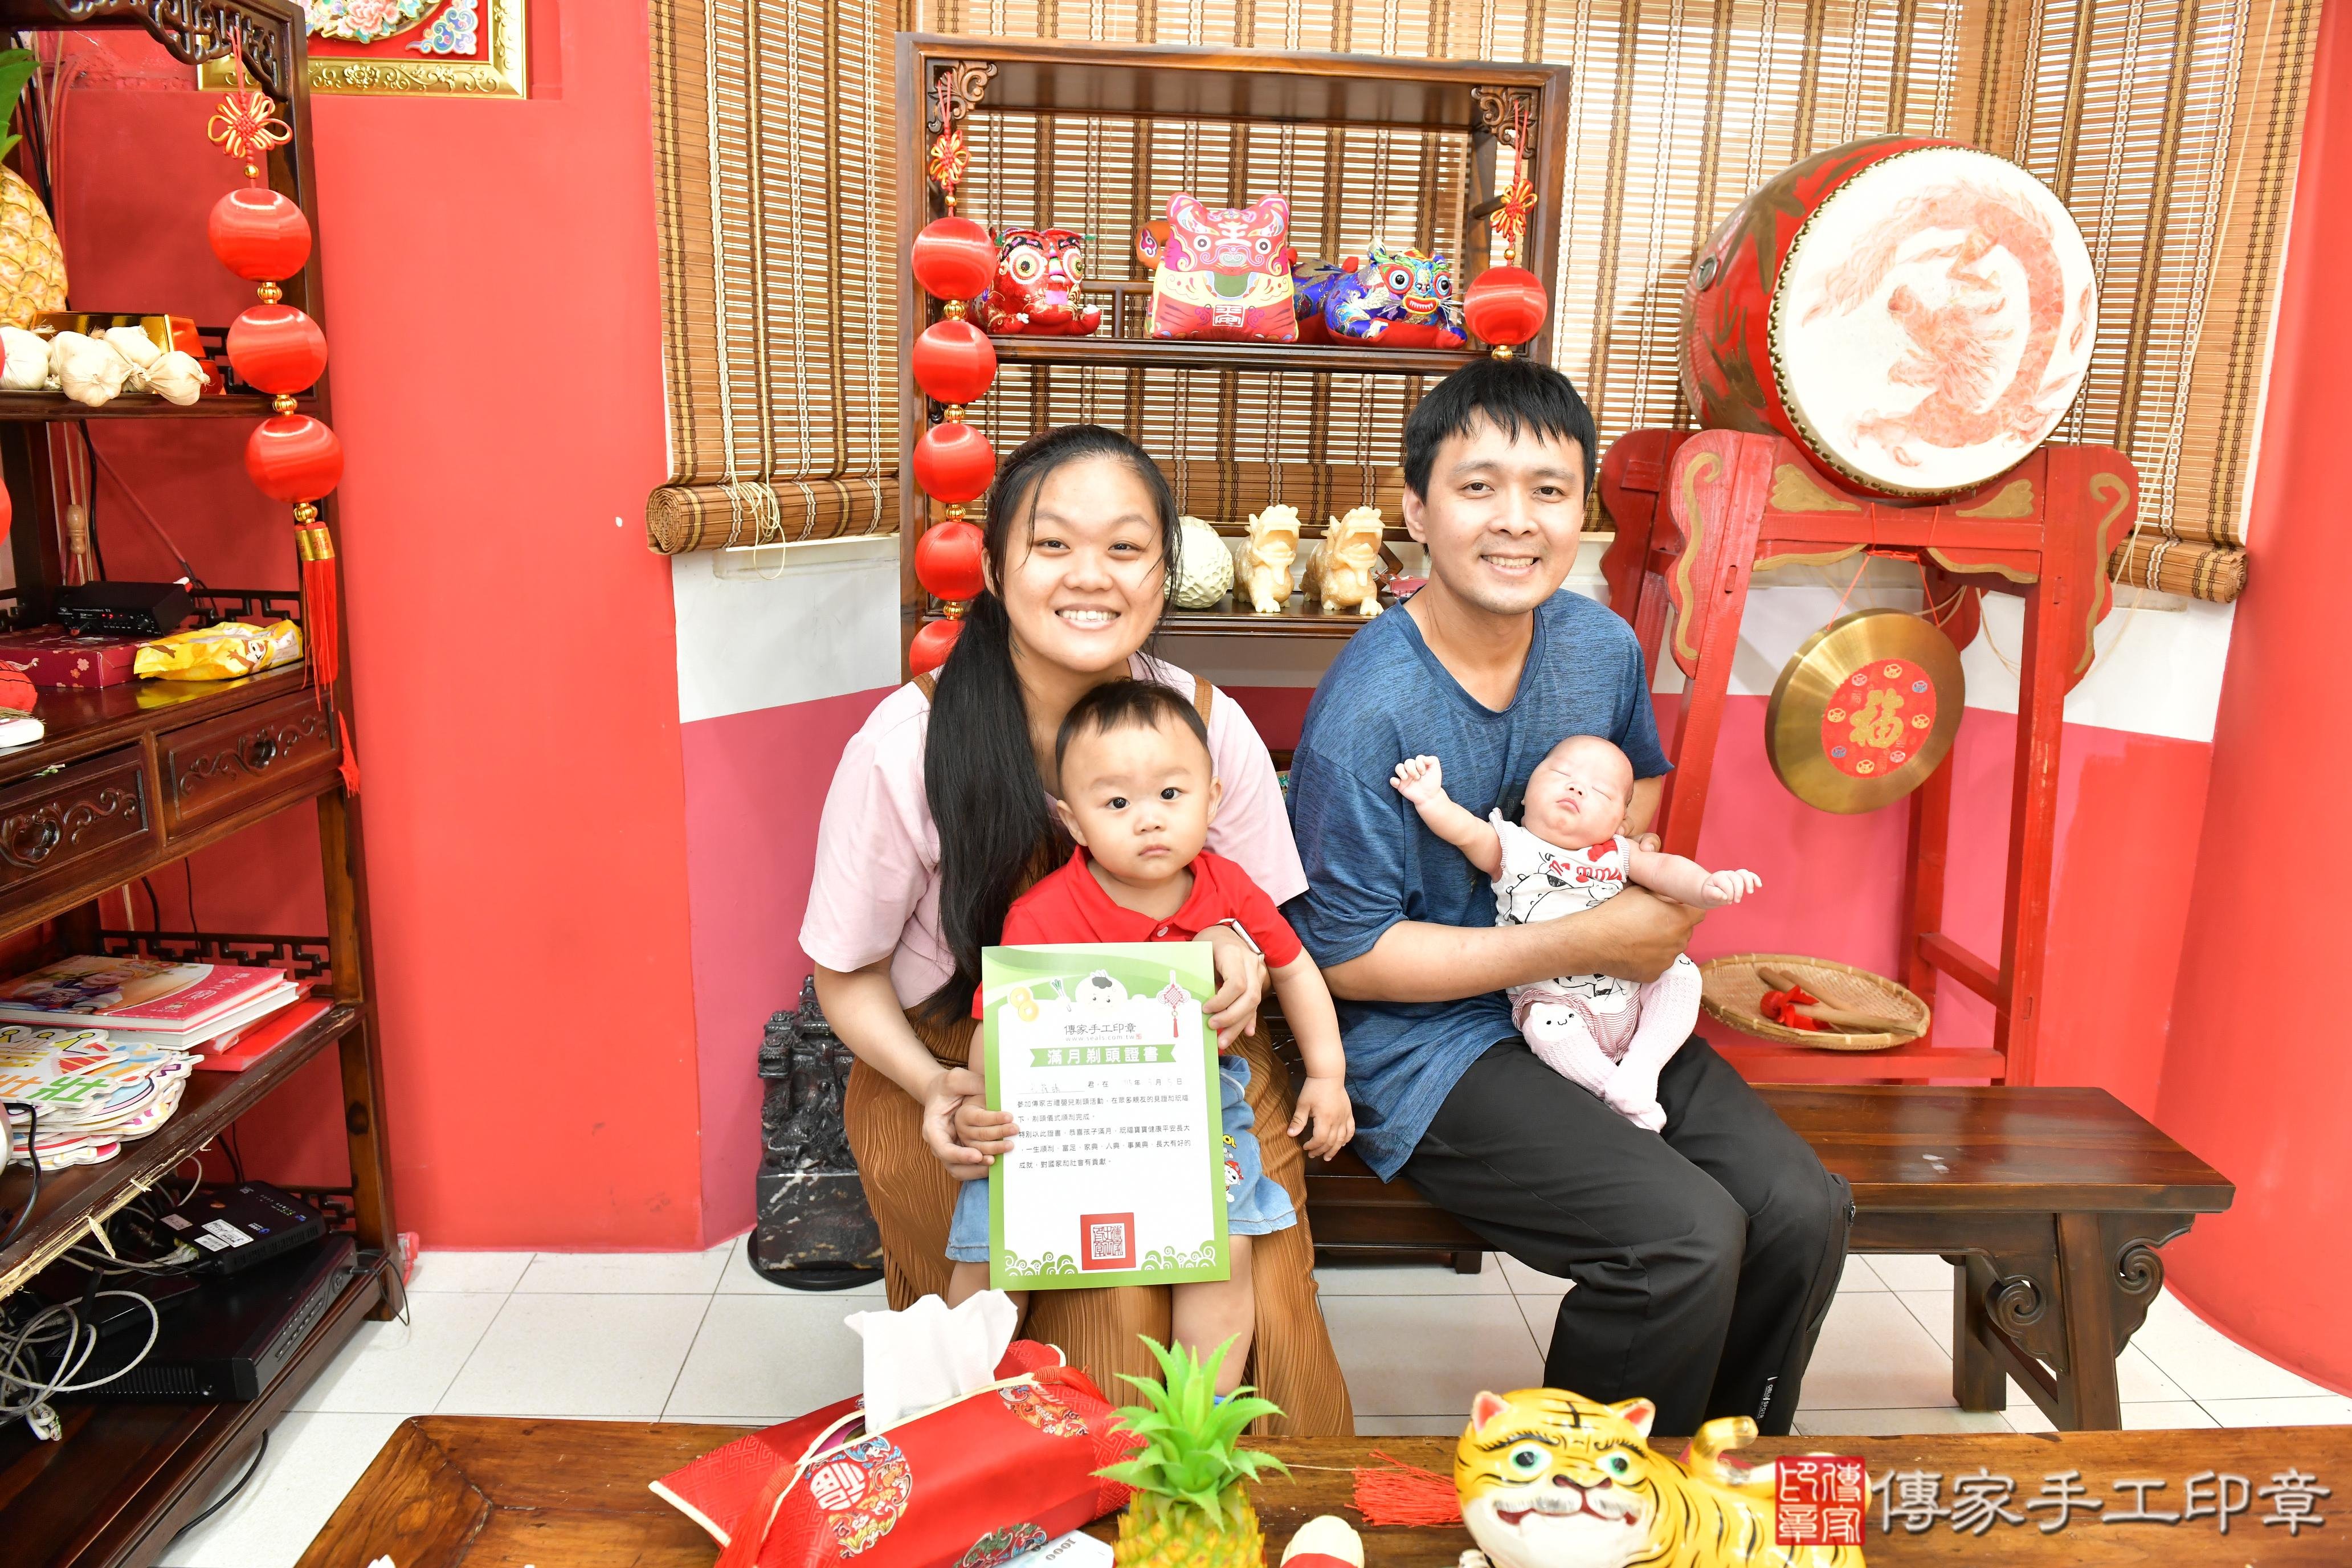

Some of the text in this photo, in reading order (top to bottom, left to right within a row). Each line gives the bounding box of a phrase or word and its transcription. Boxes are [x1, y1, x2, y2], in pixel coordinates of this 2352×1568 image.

[1064, 1023, 1137, 1035] 傳家手工印章
[1047, 1046, 1158, 1065] 滿月剃頭證書
[1045, 1537, 1077, 1561] 1000
